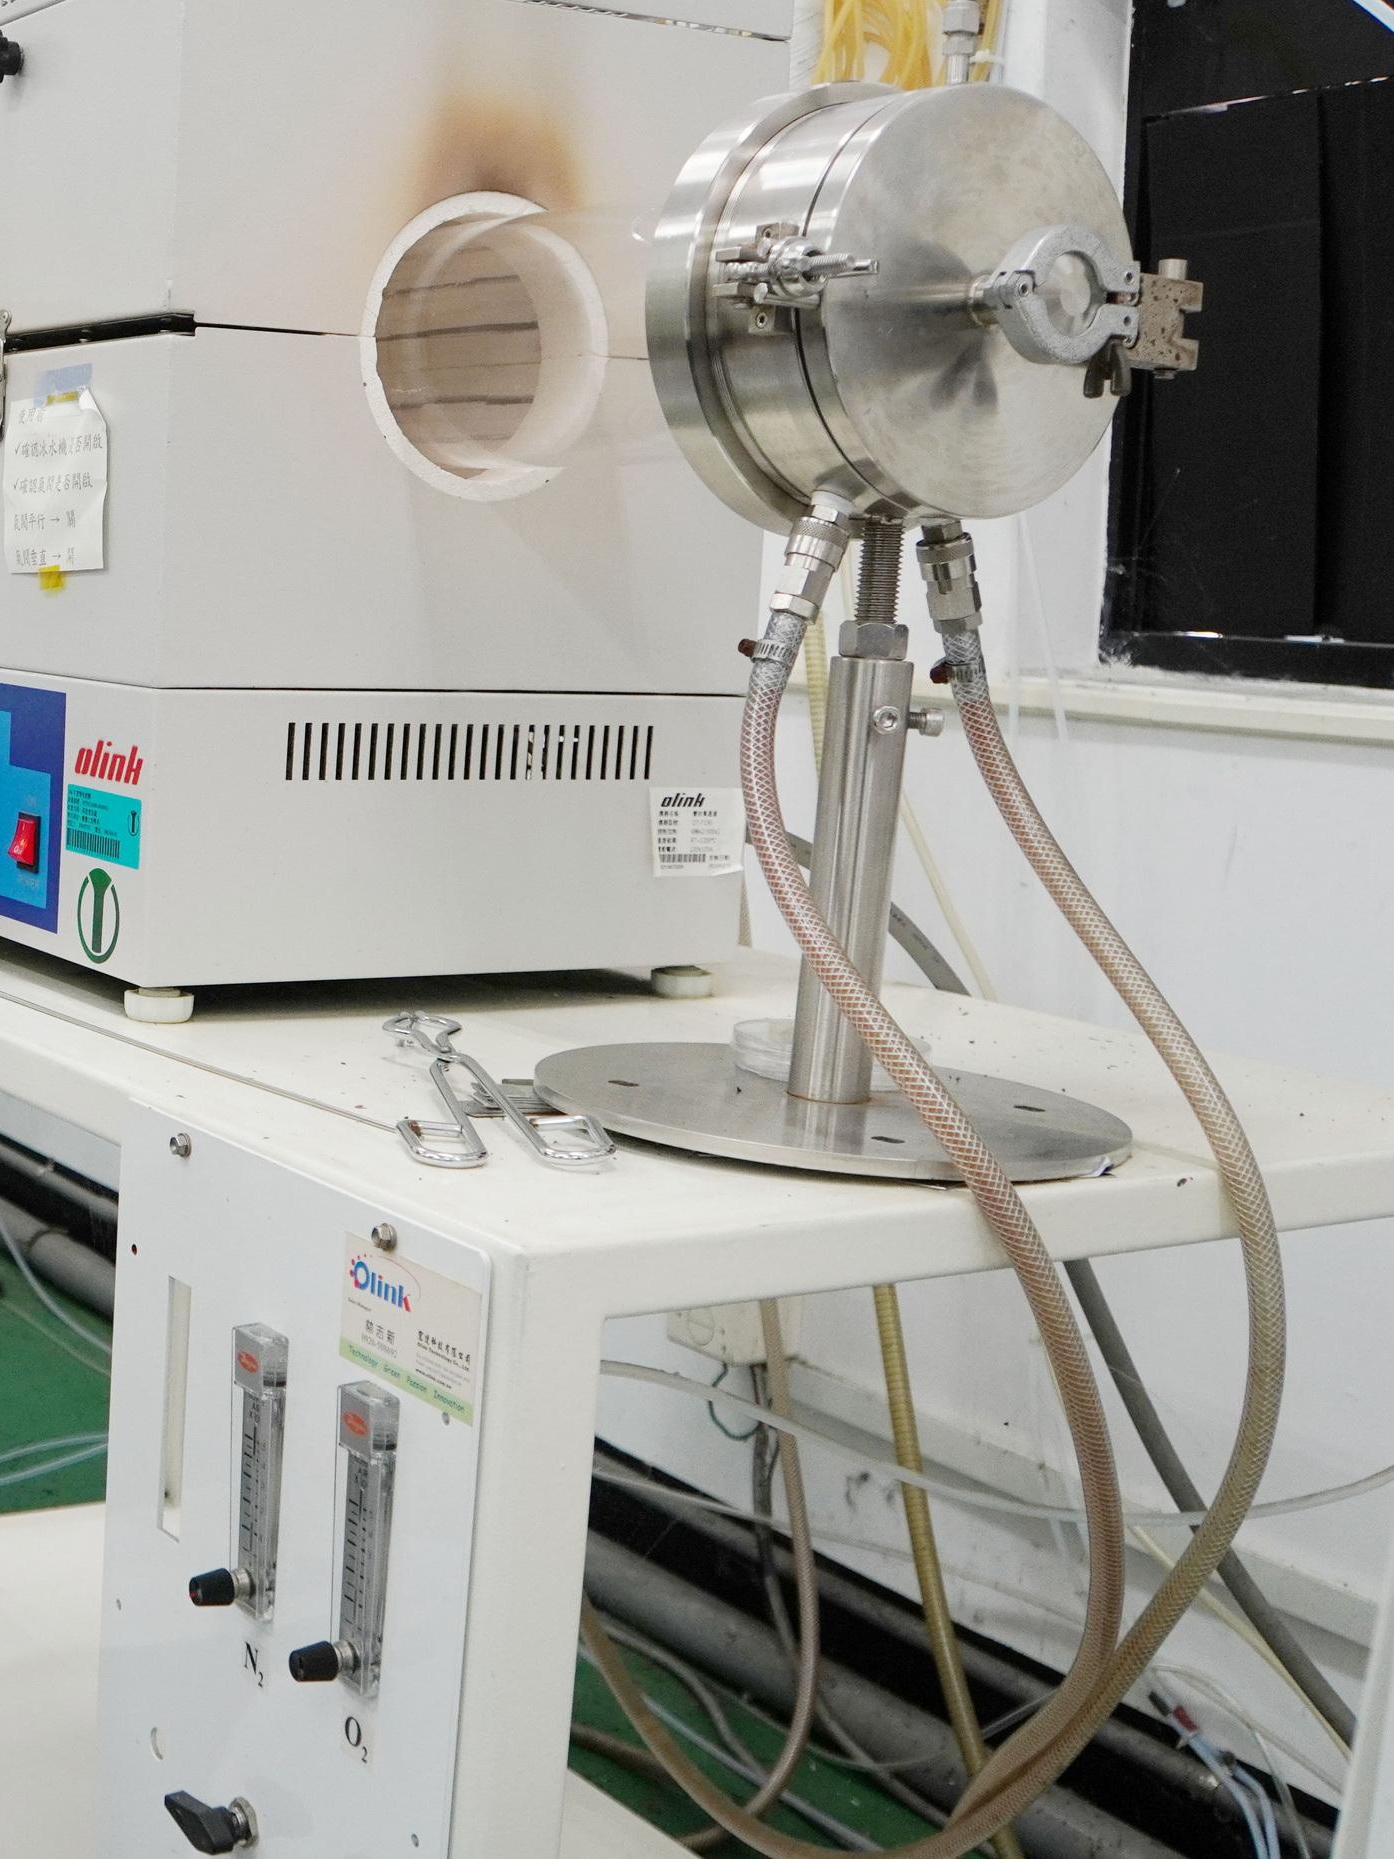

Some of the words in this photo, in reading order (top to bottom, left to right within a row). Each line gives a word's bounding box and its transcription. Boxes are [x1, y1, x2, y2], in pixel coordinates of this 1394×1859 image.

[74, 740, 143, 785] olink
[661, 792, 705, 808] olink
[352, 1260, 412, 1313] Olink
[349, 1344, 378, 1368] Technology
[434, 1390, 464, 1412] Innovation
